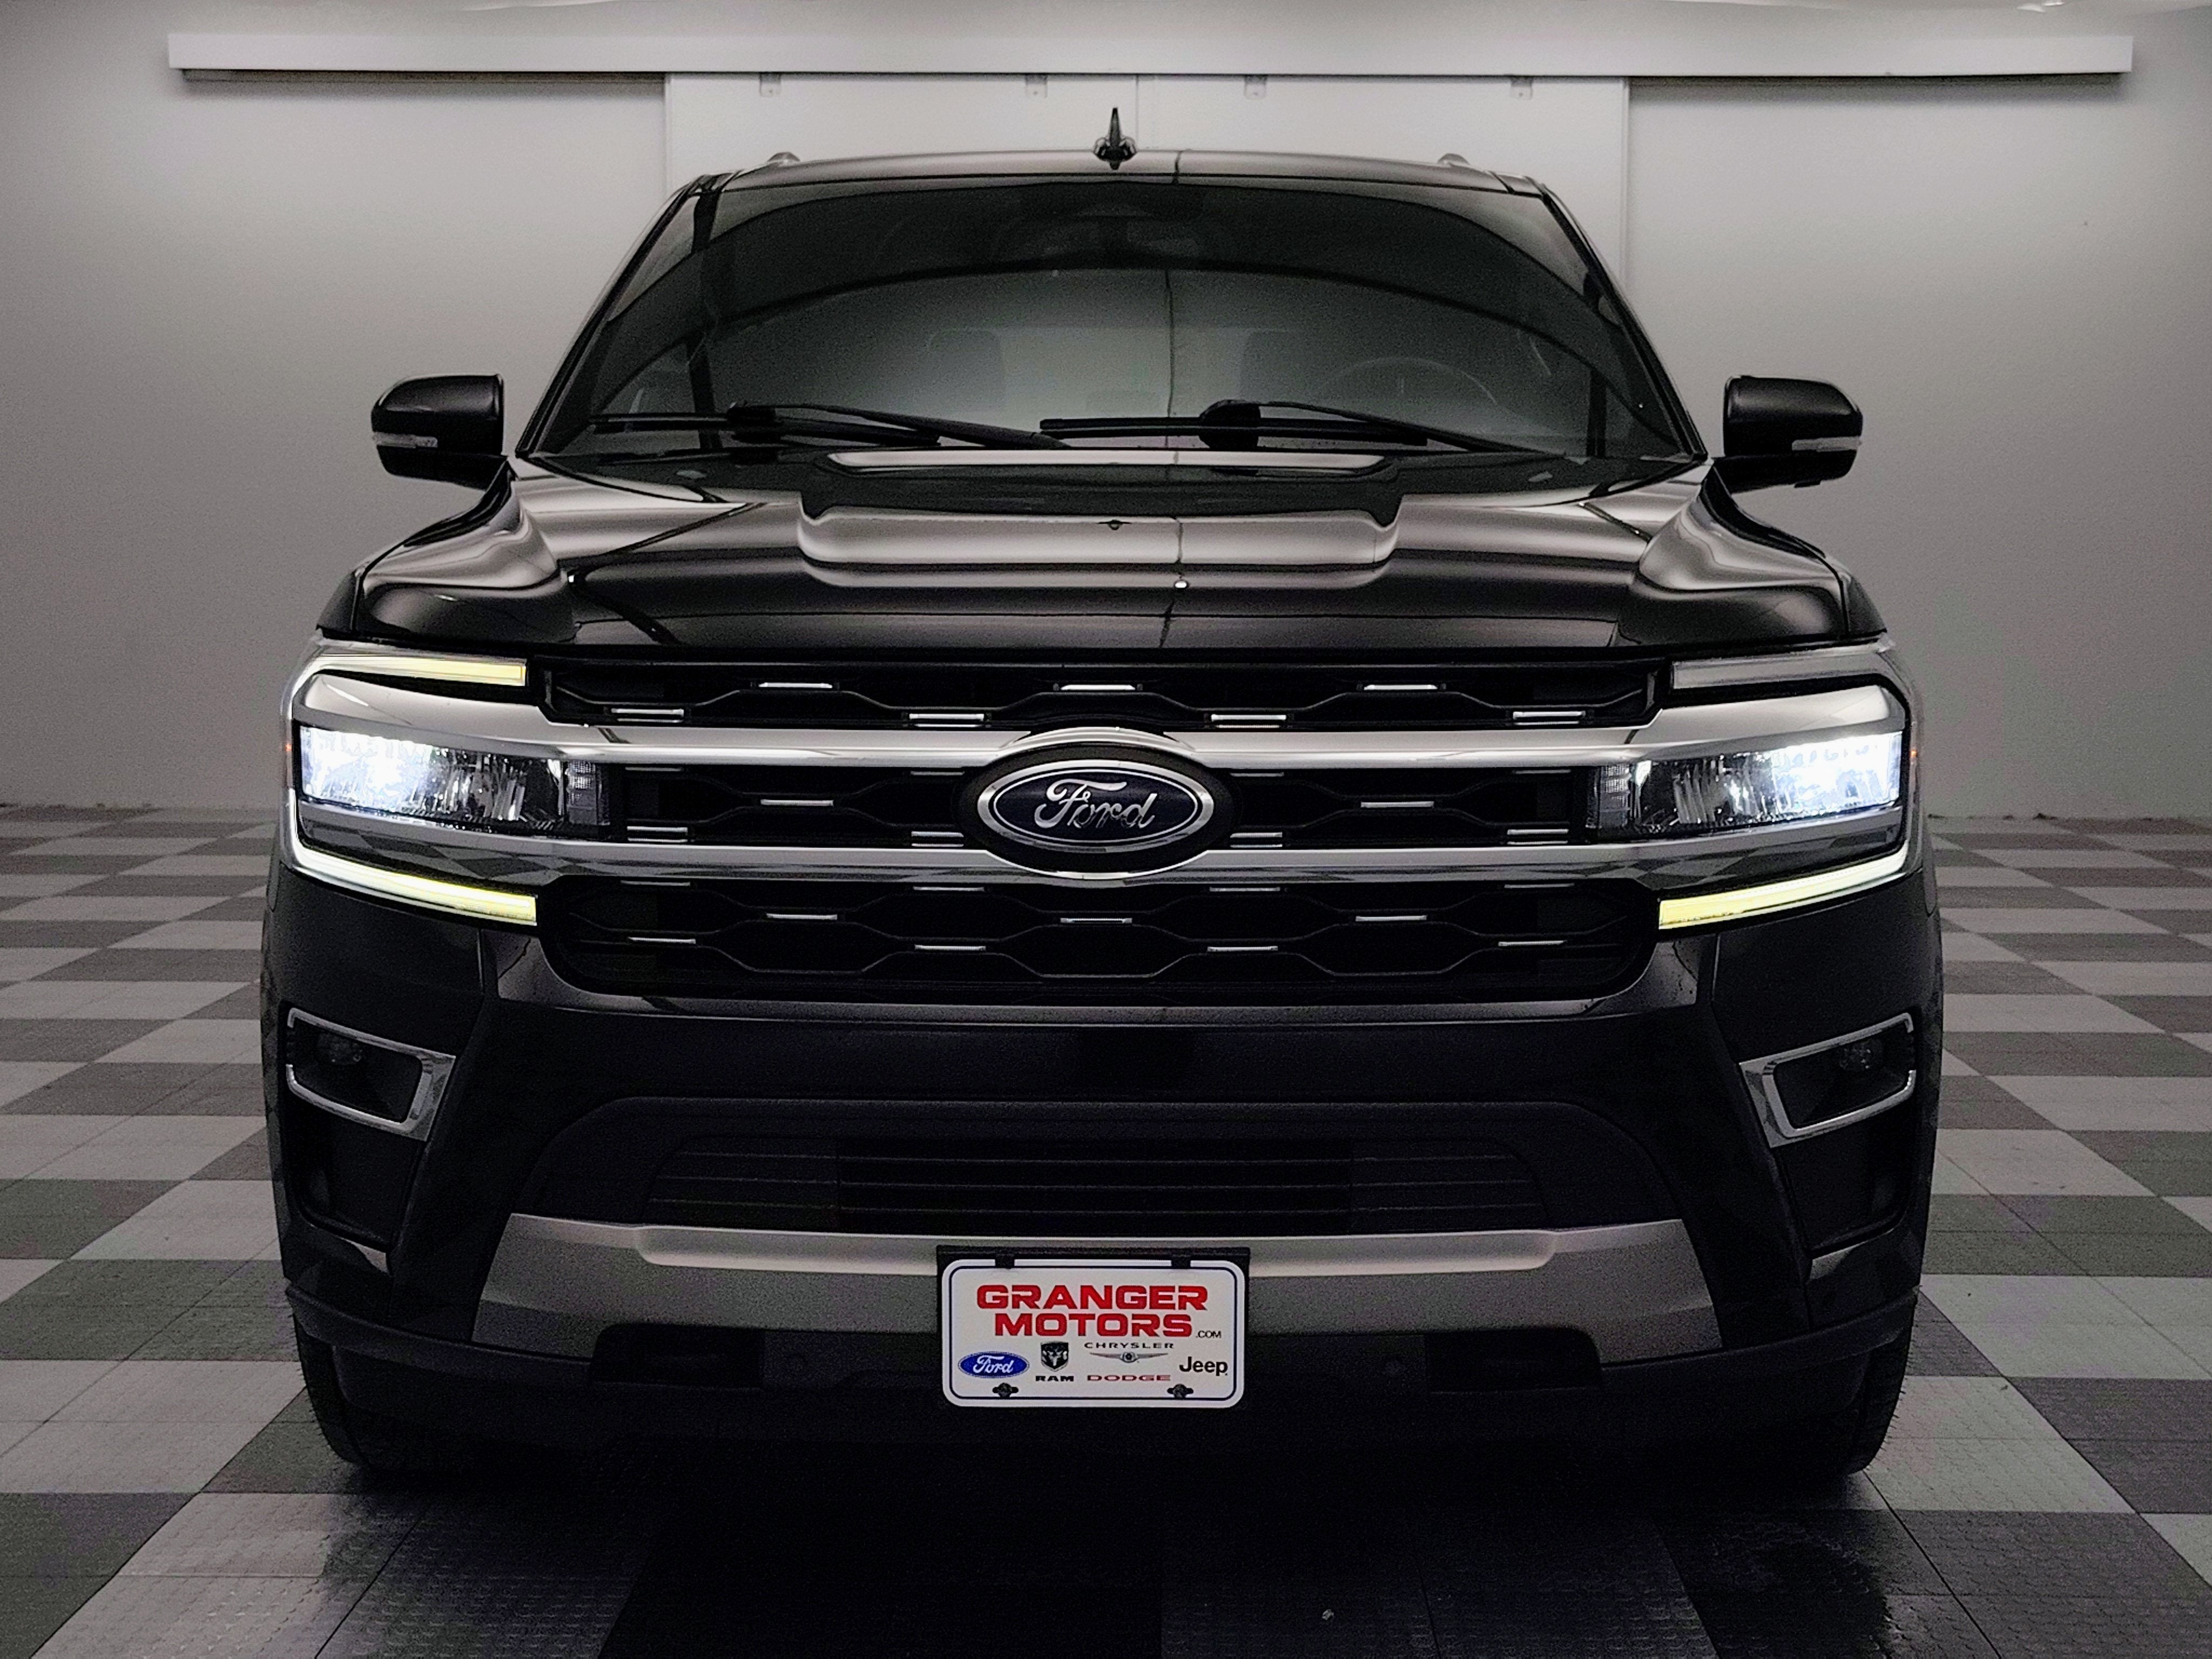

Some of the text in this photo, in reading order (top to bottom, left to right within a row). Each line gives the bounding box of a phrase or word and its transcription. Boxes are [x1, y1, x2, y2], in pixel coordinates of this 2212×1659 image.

[1034, 779, 1157, 828] Ford
[976, 1284, 1208, 1310] GRANGER
[994, 1313, 1192, 1337] MOTORS
[972, 1355, 1015, 1374] Ford
[1179, 1357, 1228, 1375] Jeep
